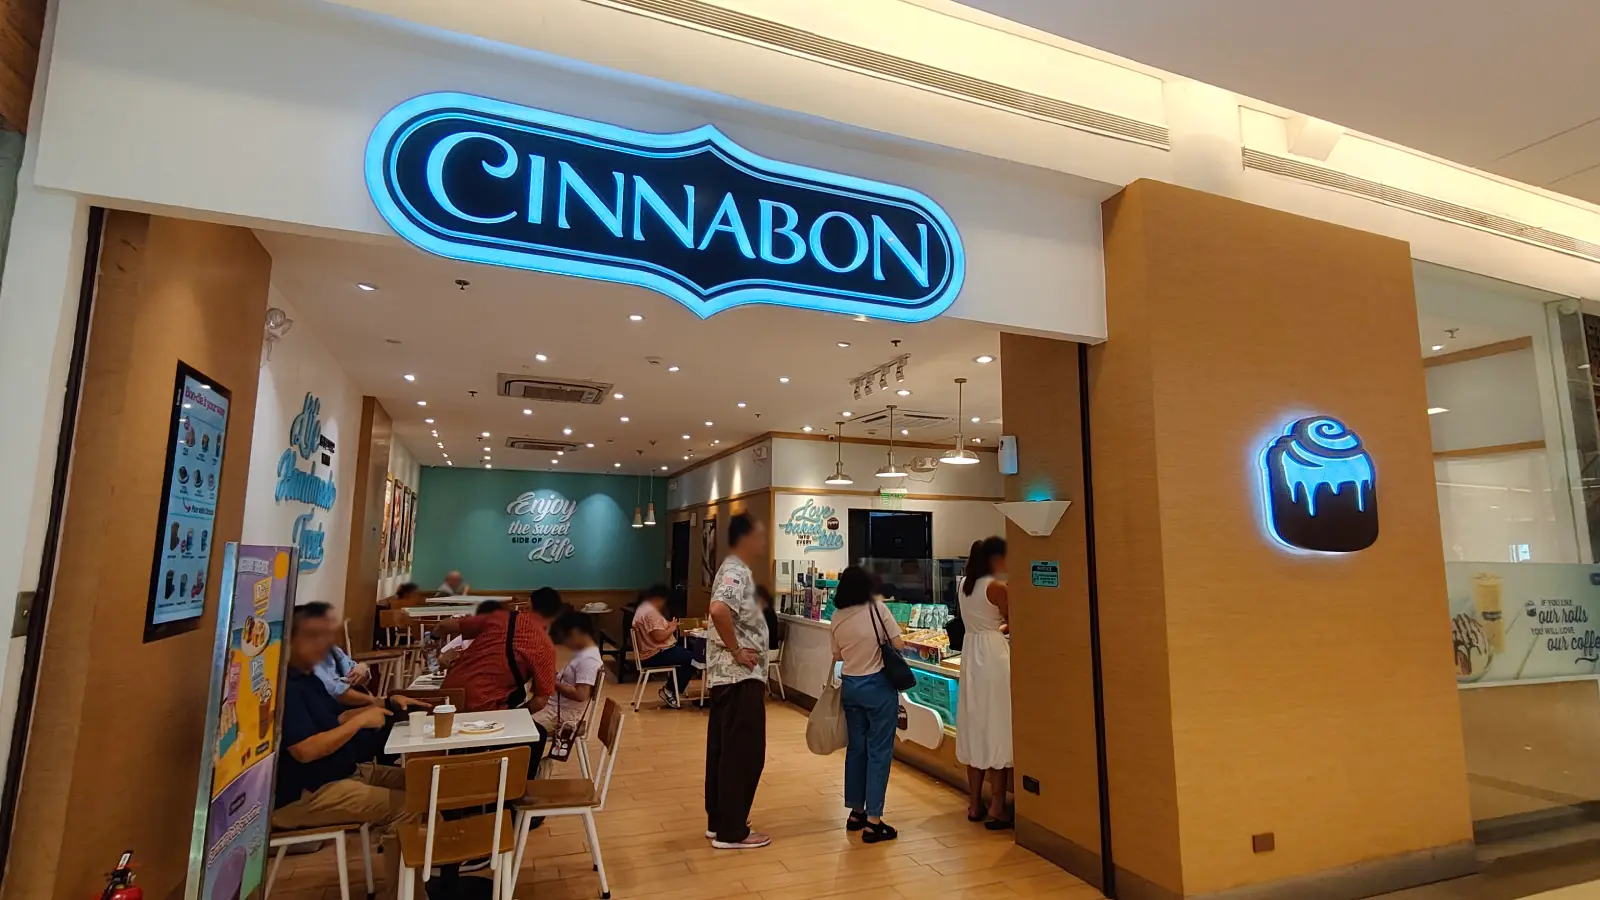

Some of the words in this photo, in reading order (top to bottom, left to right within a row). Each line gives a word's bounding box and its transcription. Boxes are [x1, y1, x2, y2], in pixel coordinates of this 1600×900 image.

[426, 131, 931, 287] CINNABON
[507, 491, 577, 523] Enjoy
[791, 498, 835, 523] Love
[508, 520, 531, 535] the
[532, 521, 571, 536] sweet
[528, 538, 576, 563] Life
[1538, 608, 1560, 624] our
[1561, 604, 1588, 623] rolls
[1530, 627, 1543, 635] YOU
[1544, 627, 1559, 635] WILL
[1560, 626, 1575, 635] LOVE
[1547, 636, 1569, 651] our
